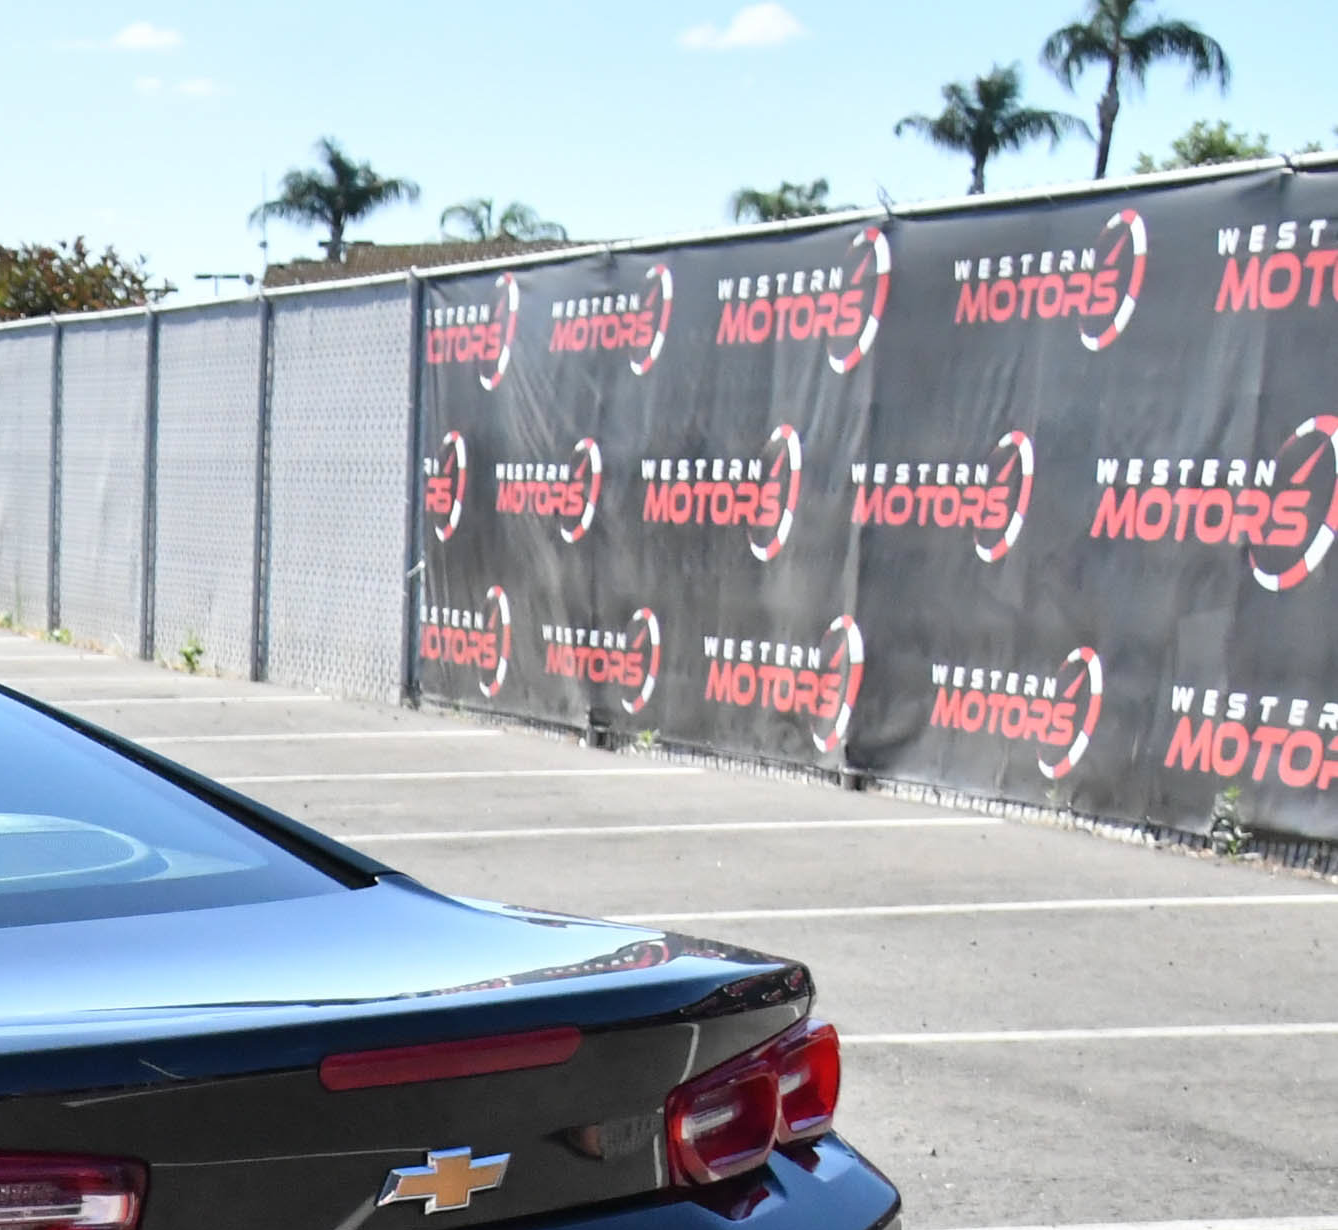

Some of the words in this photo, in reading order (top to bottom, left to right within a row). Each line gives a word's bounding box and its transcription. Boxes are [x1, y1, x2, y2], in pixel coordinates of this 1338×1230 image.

[954, 248, 1096, 281] WESTERN
[718, 266, 843, 301] WESTERN
[954, 269, 1120, 325] MOTORS
[552, 293, 640, 318] WESTERN
[716, 289, 864, 345] MOTORS
[549, 311, 654, 353] MOTORS
[641, 458, 762, 481] WESTERN
[851, 462, 989, 485] WESTERN
[1096, 458, 1277, 487] WESTERN
[495, 480, 584, 516] MOTORS
[643, 480, 781, 526] MOTORS
[851, 483, 1010, 529] MOTORS
[1090, 486, 1312, 547] MOTORS
[542, 624, 627, 649] WESTERN
[704, 635, 821, 670] WESTERN
[545, 642, 644, 687] MOTORS
[932, 663, 1057, 699] WESTERN
[704, 658, 842, 719] MOTORS
[930, 686, 1077, 746] MOTORS
